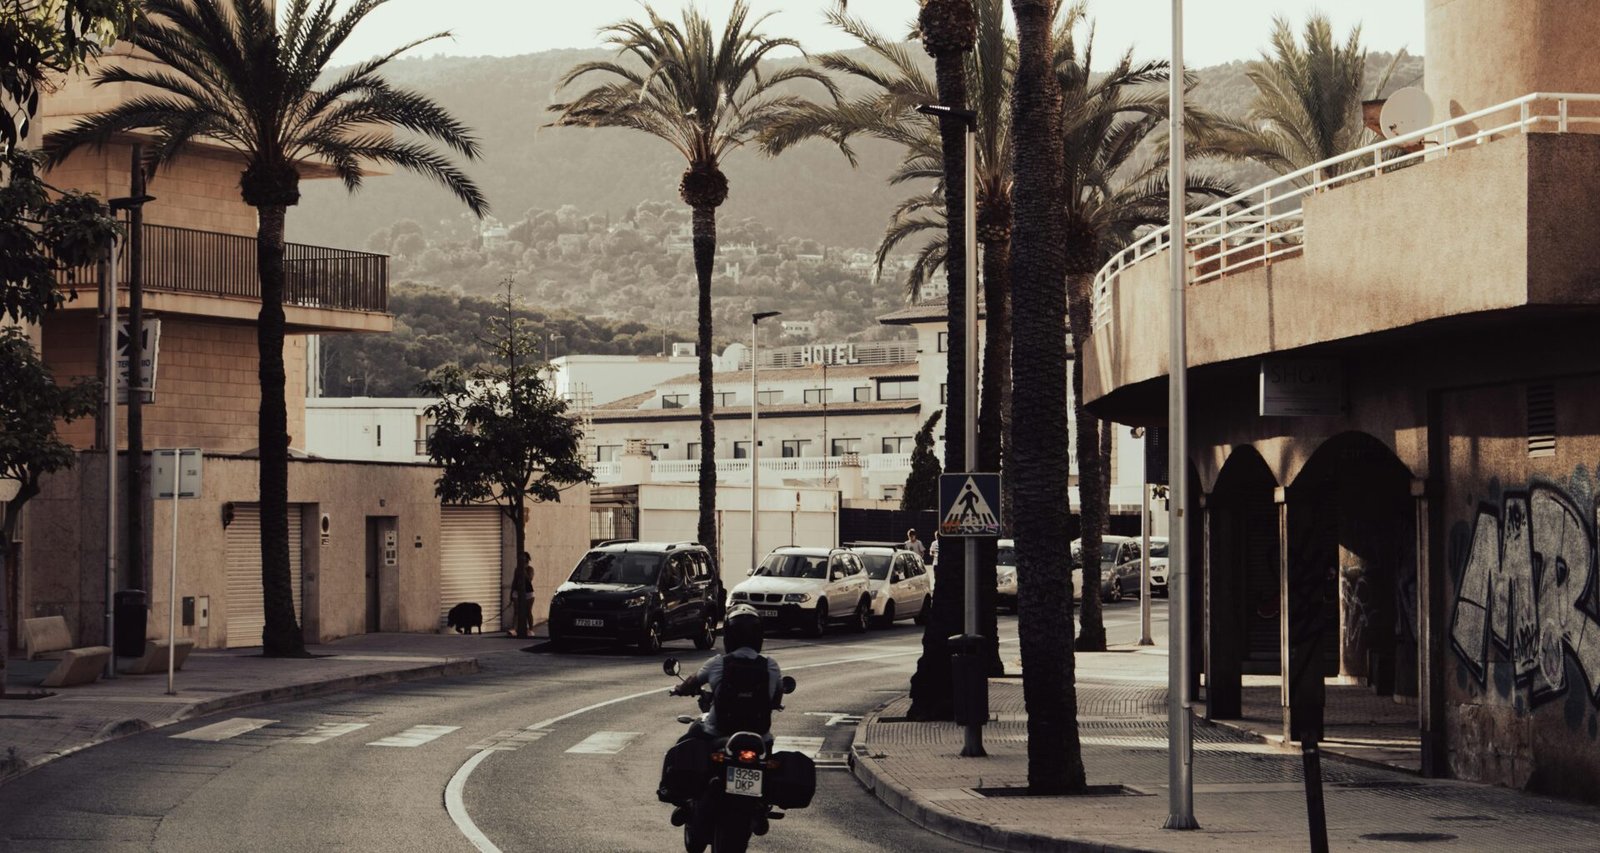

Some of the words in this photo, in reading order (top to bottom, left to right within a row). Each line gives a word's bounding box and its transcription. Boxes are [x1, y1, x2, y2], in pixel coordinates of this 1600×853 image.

[801, 343, 858, 365] HOTEL
[735, 769, 760, 781] 9298
[735, 780, 754, 791] DKP
